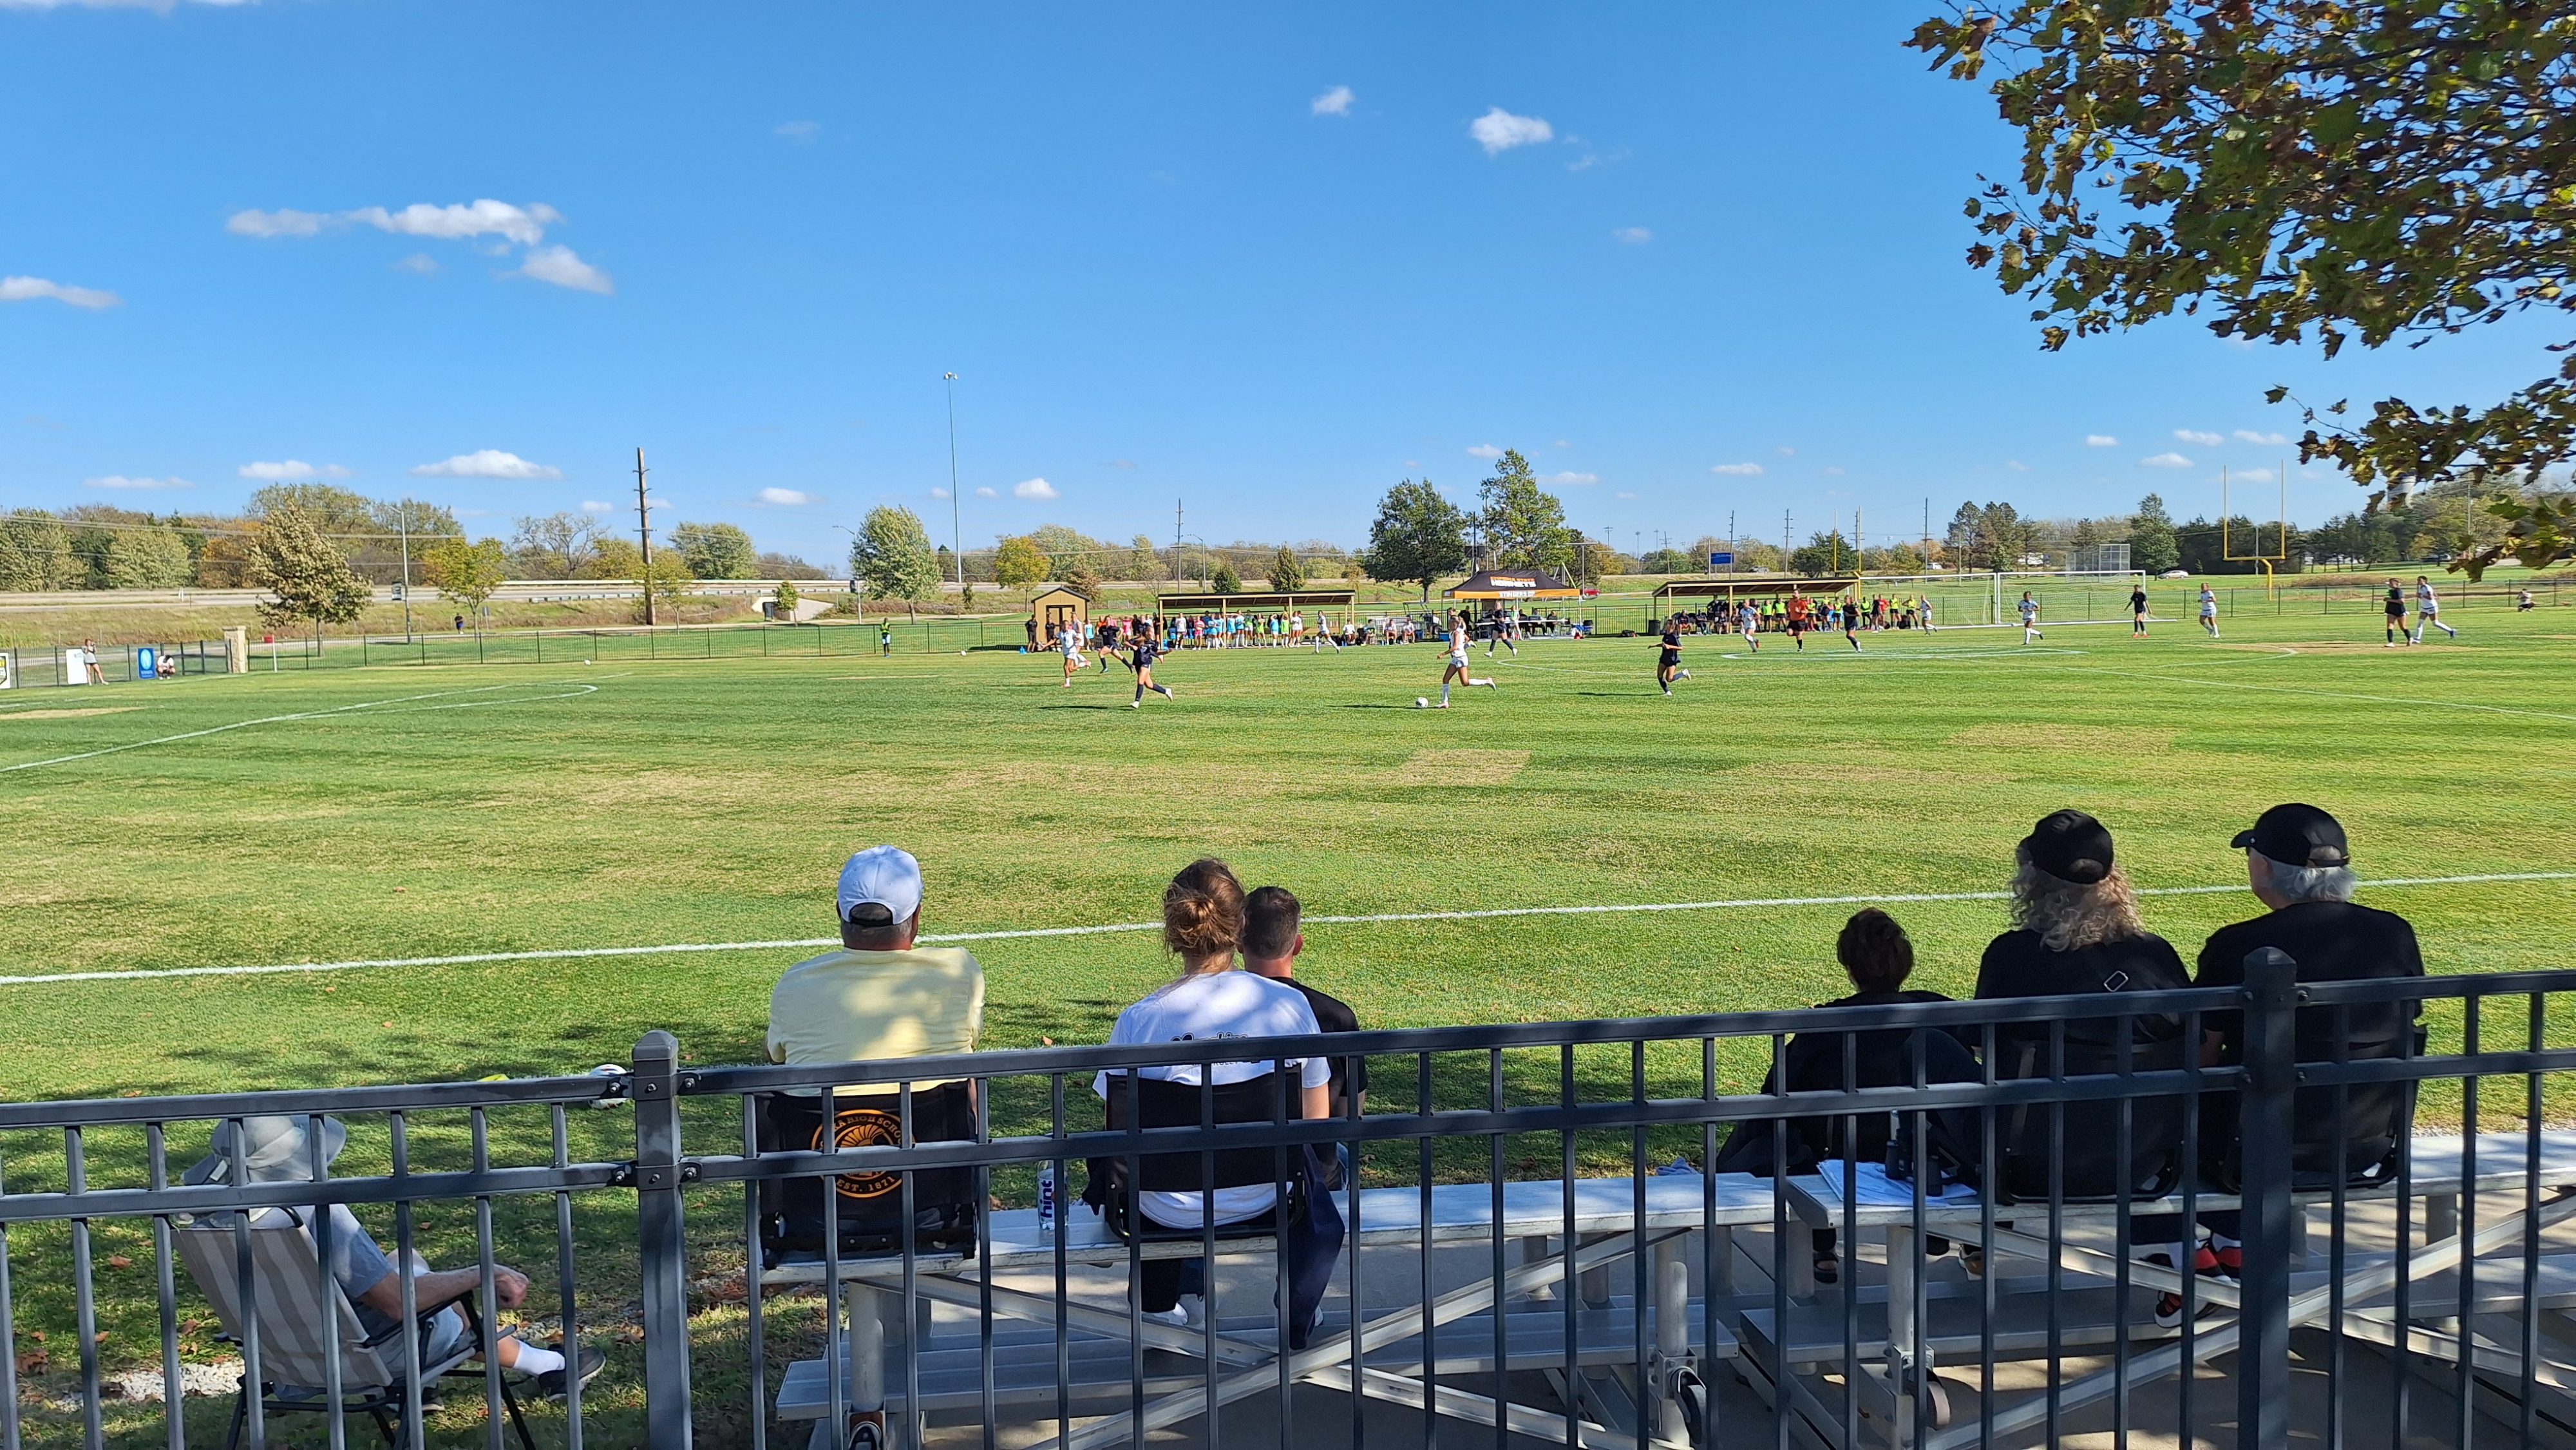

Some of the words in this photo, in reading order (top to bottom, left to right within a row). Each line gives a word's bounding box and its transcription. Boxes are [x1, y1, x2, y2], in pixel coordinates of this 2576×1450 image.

[846, 1115, 876, 1124] HIGH
[836, 1178, 864, 1192] EST.
[868, 1176, 896, 1191] 1871
[1040, 1180, 1052, 1218] hint
